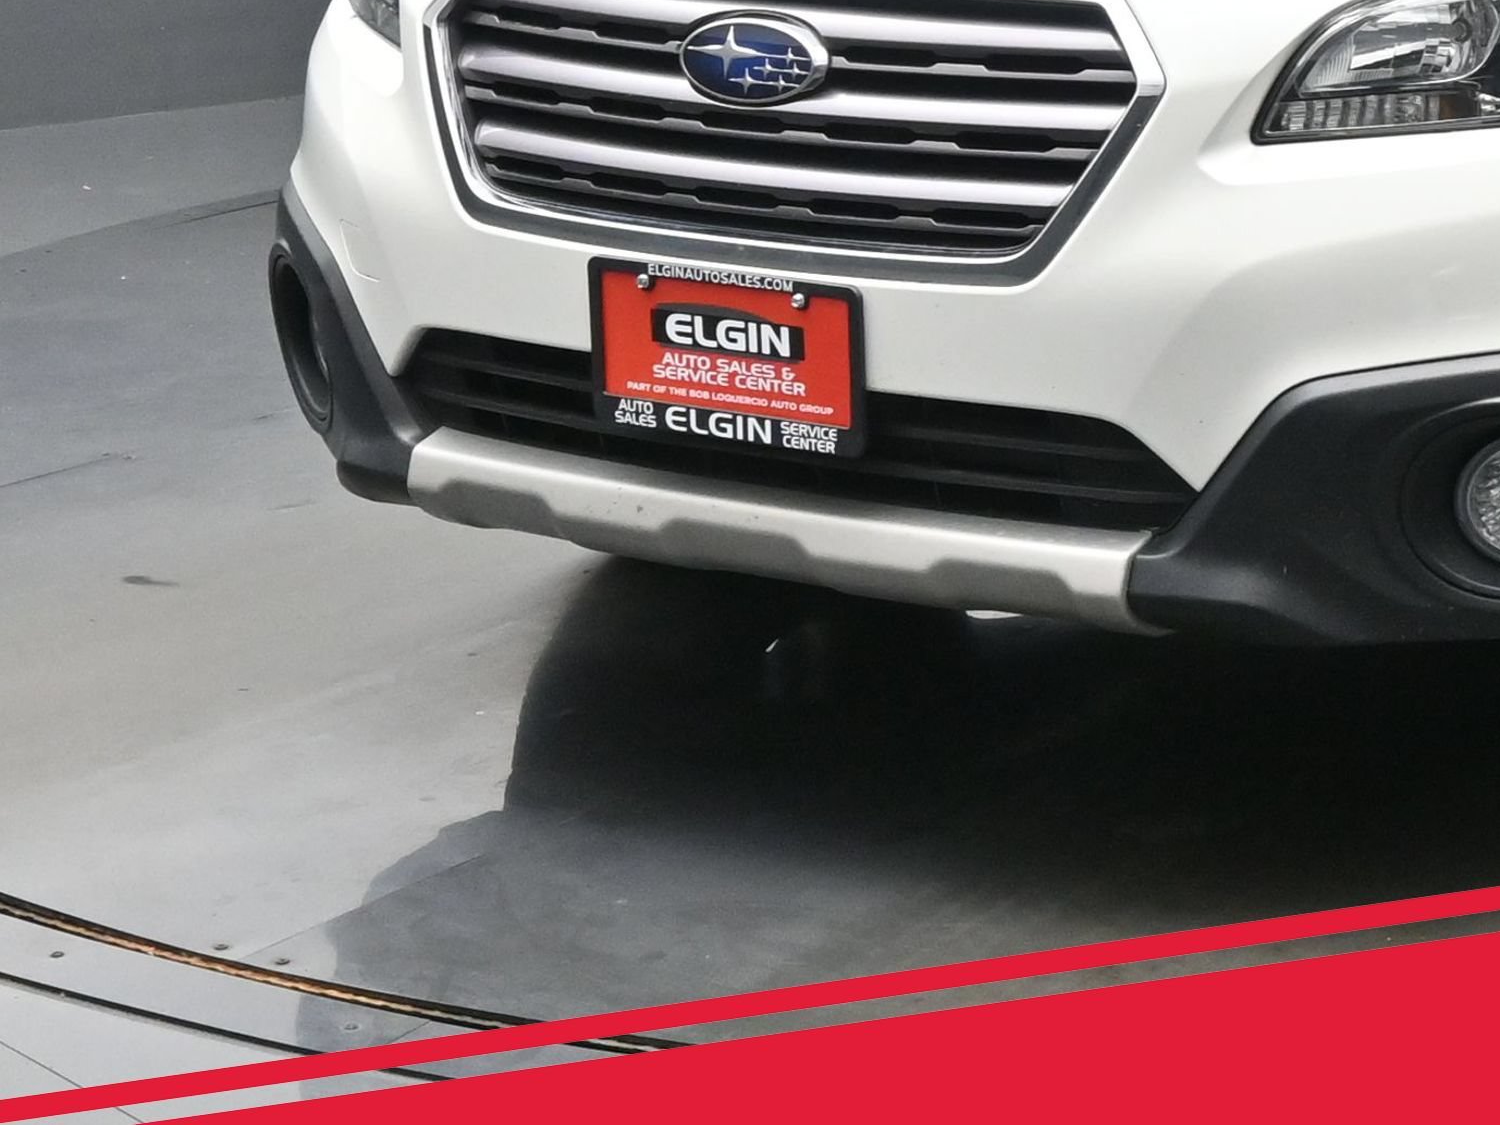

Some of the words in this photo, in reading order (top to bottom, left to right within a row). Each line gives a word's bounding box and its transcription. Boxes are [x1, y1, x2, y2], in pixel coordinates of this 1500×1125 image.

[647, 263, 794, 293] ELGINAUTOSALES.COM
[665, 312, 791, 358] ELGIN
[652, 364, 730, 387] SERVICE
[735, 375, 807, 397] CENTER
[661, 351, 711, 370] AUTO
[716, 358, 775, 378] SALES
[781, 368, 796, 381] &
[617, 398, 654, 415] AUTO
[626, 381, 651, 392] PART
[653, 384, 667, 394] OF
[669, 387, 688, 397] THE
[689, 390, 710, 400] BOB
[712, 392, 769, 407] LOQUERCIO
[770, 399, 798, 411] AUTO
[799, 403, 835, 415] GROUP
[614, 410, 657, 428] SALES
[664, 405, 773, 445] ELGIN
[780, 421, 838, 442] SERVICE
[782, 435, 836, 455] CENTER
